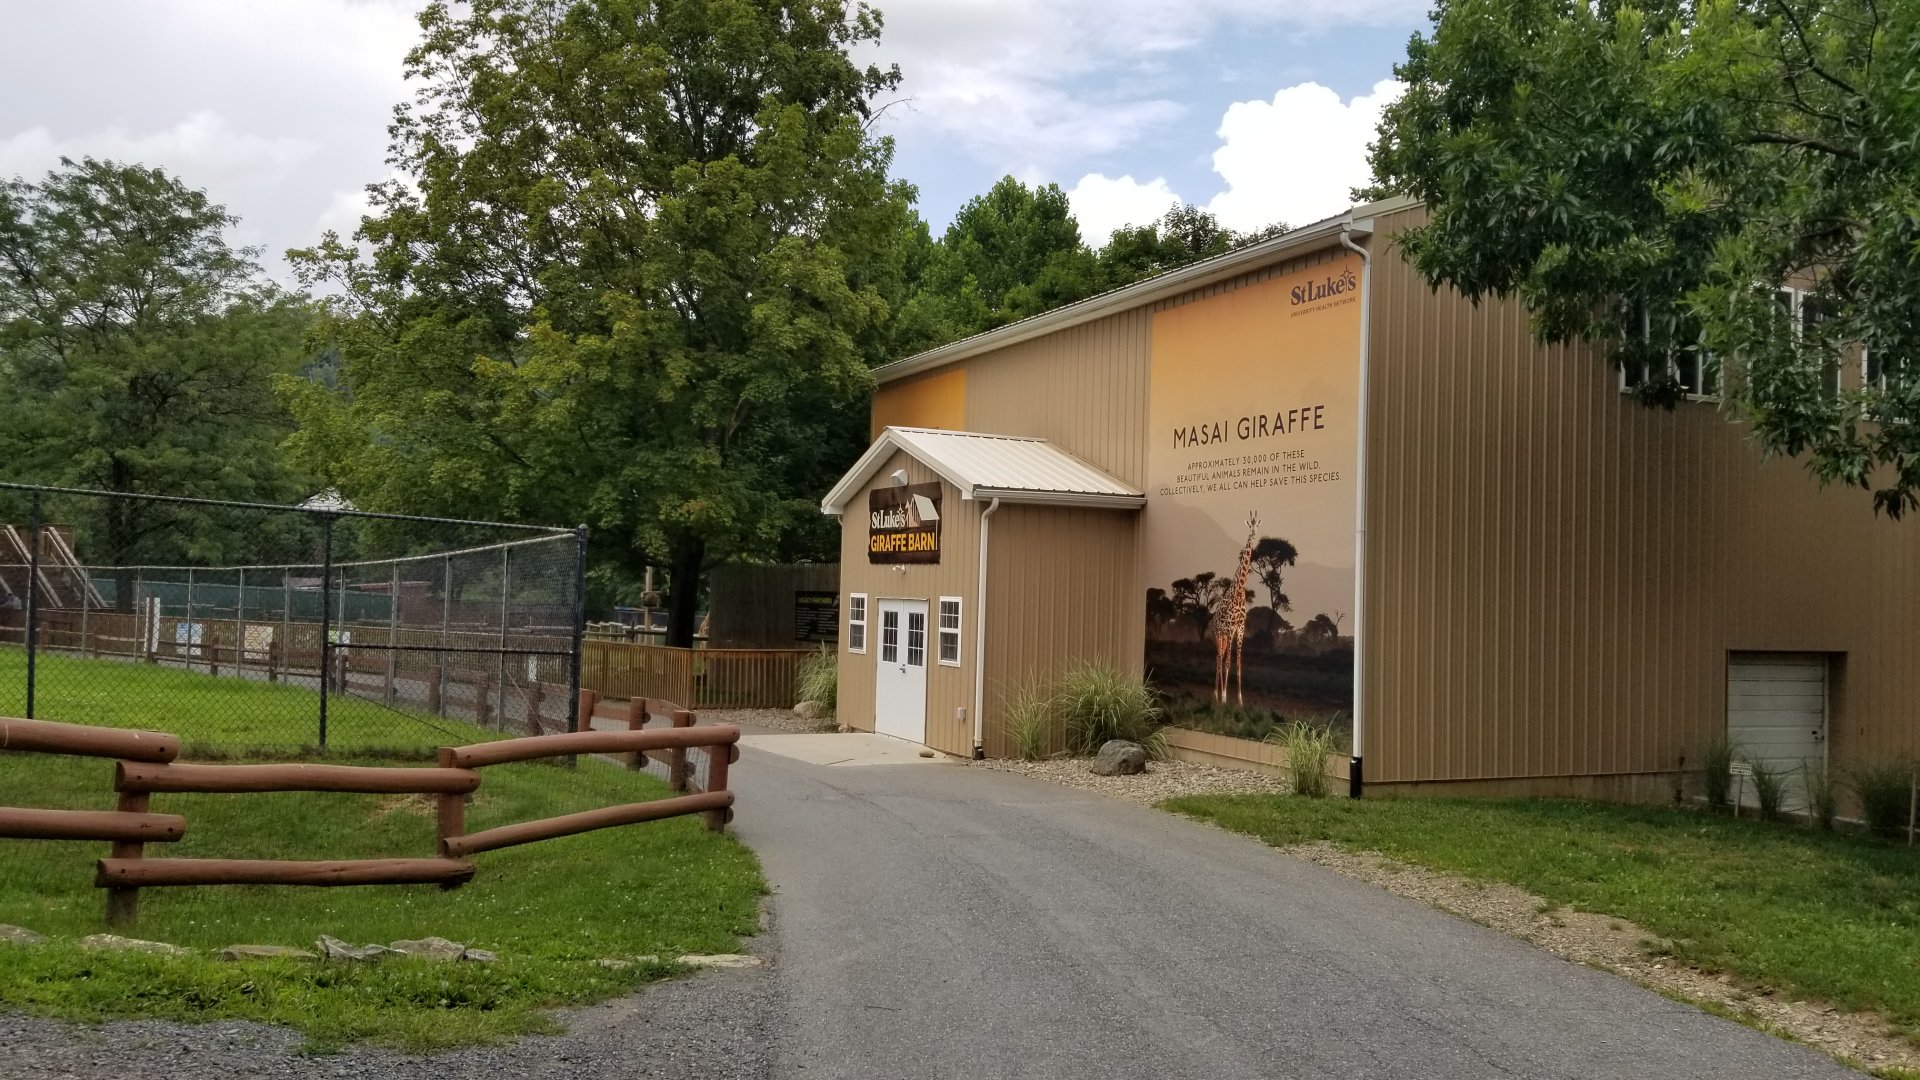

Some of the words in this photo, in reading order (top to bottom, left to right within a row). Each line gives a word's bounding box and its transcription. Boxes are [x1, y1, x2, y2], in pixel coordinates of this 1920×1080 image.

[1290, 307, 1315, 318] UNIVERSITY
[1316, 302, 1333, 311] HEALTH
[1333, 297, 1356, 307] NETWORK
[1173, 420, 1228, 449] MASAI
[1237, 405, 1325, 440] GIRAFFE
[1187, 457, 1240, 471] APPROXIMATELY
[1242, 454, 1267, 465] 30,000
[1269, 452, 1280, 462] OF
[1282, 449, 1305, 461] THESE
[1159, 484, 1206, 496] COLLECTIVELY,
[1207, 483, 1217, 492] WE
[1219, 482, 1231, 491] ALL
[1233, 480, 1249, 490] CAN
[1250, 478, 1267, 489] HELP
[1269, 476, 1288, 487] SAVE
[1290, 475, 1307, 485] THIS
[1309, 471, 1342, 483] SPECIES.
[1176, 472, 1210, 484] BEAUTIFUL
[1211, 469, 1241, 480] ANIMALS
[1242, 466, 1269, 477] REMAIN
[1271, 464, 1280, 474] IN
[1282, 463, 1297, 473] THE
[1299, 460, 1321, 471] WILD.
[871, 534, 907, 552] GIRAFFE
[908, 532, 935, 551] BARN
